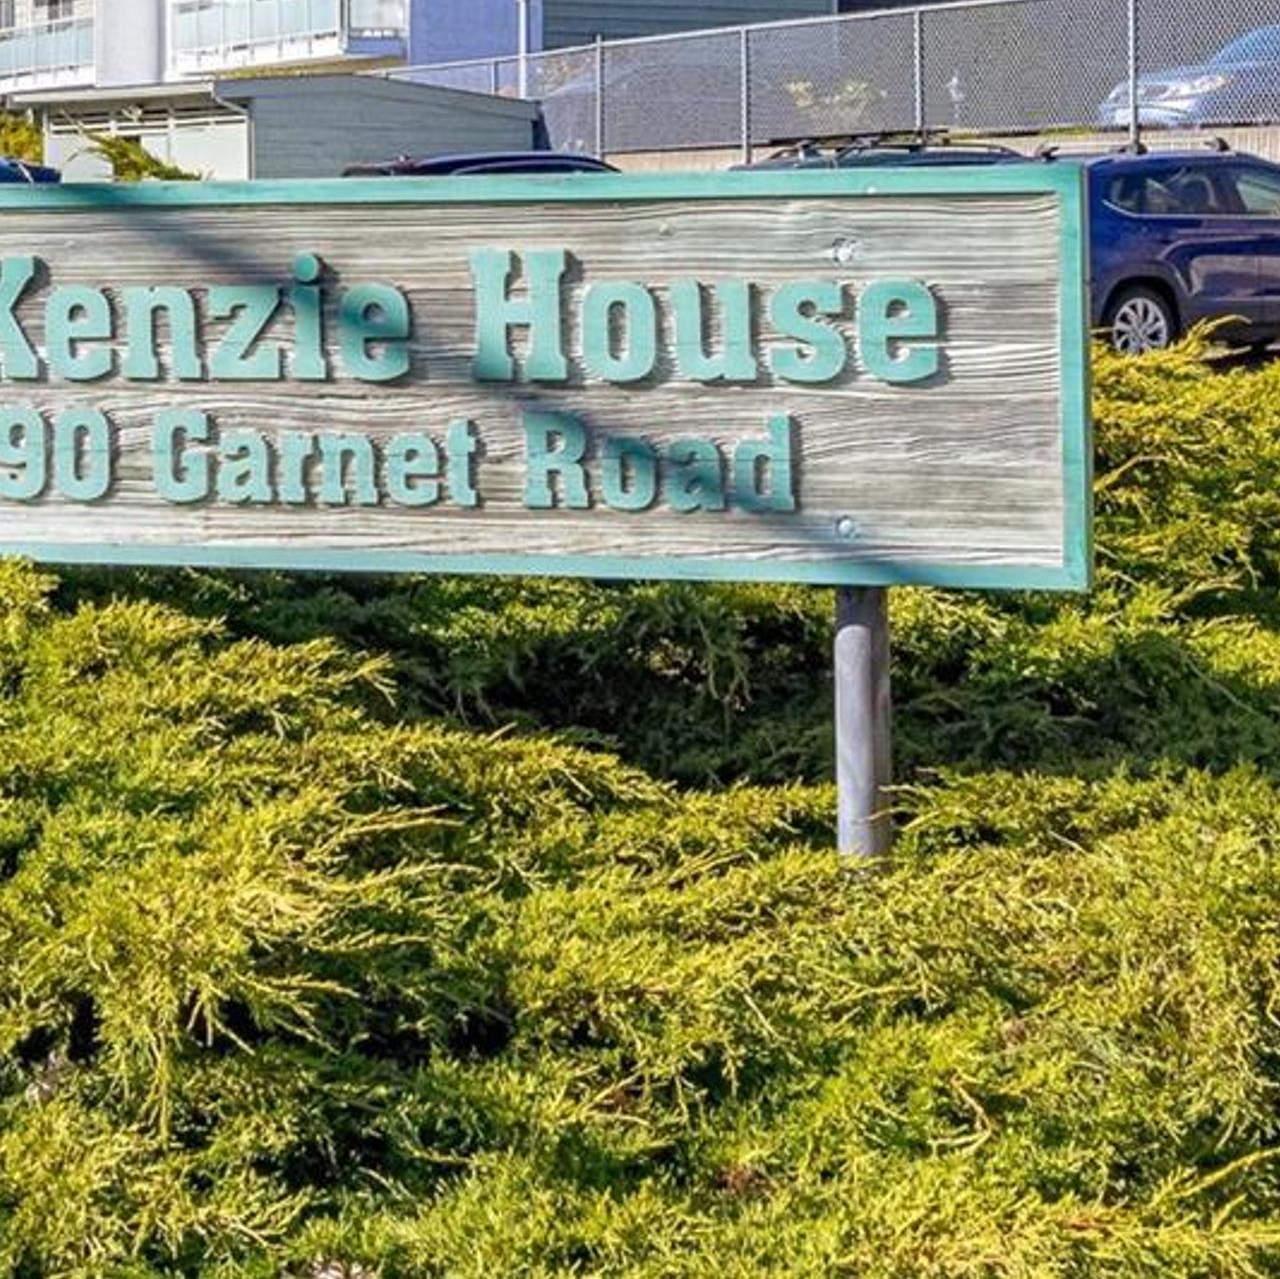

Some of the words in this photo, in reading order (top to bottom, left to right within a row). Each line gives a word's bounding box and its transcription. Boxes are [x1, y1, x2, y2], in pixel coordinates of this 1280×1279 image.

[469, 248, 939, 384] House
[152, 408, 478, 507] Garnet
[522, 410, 796, 513] Road
